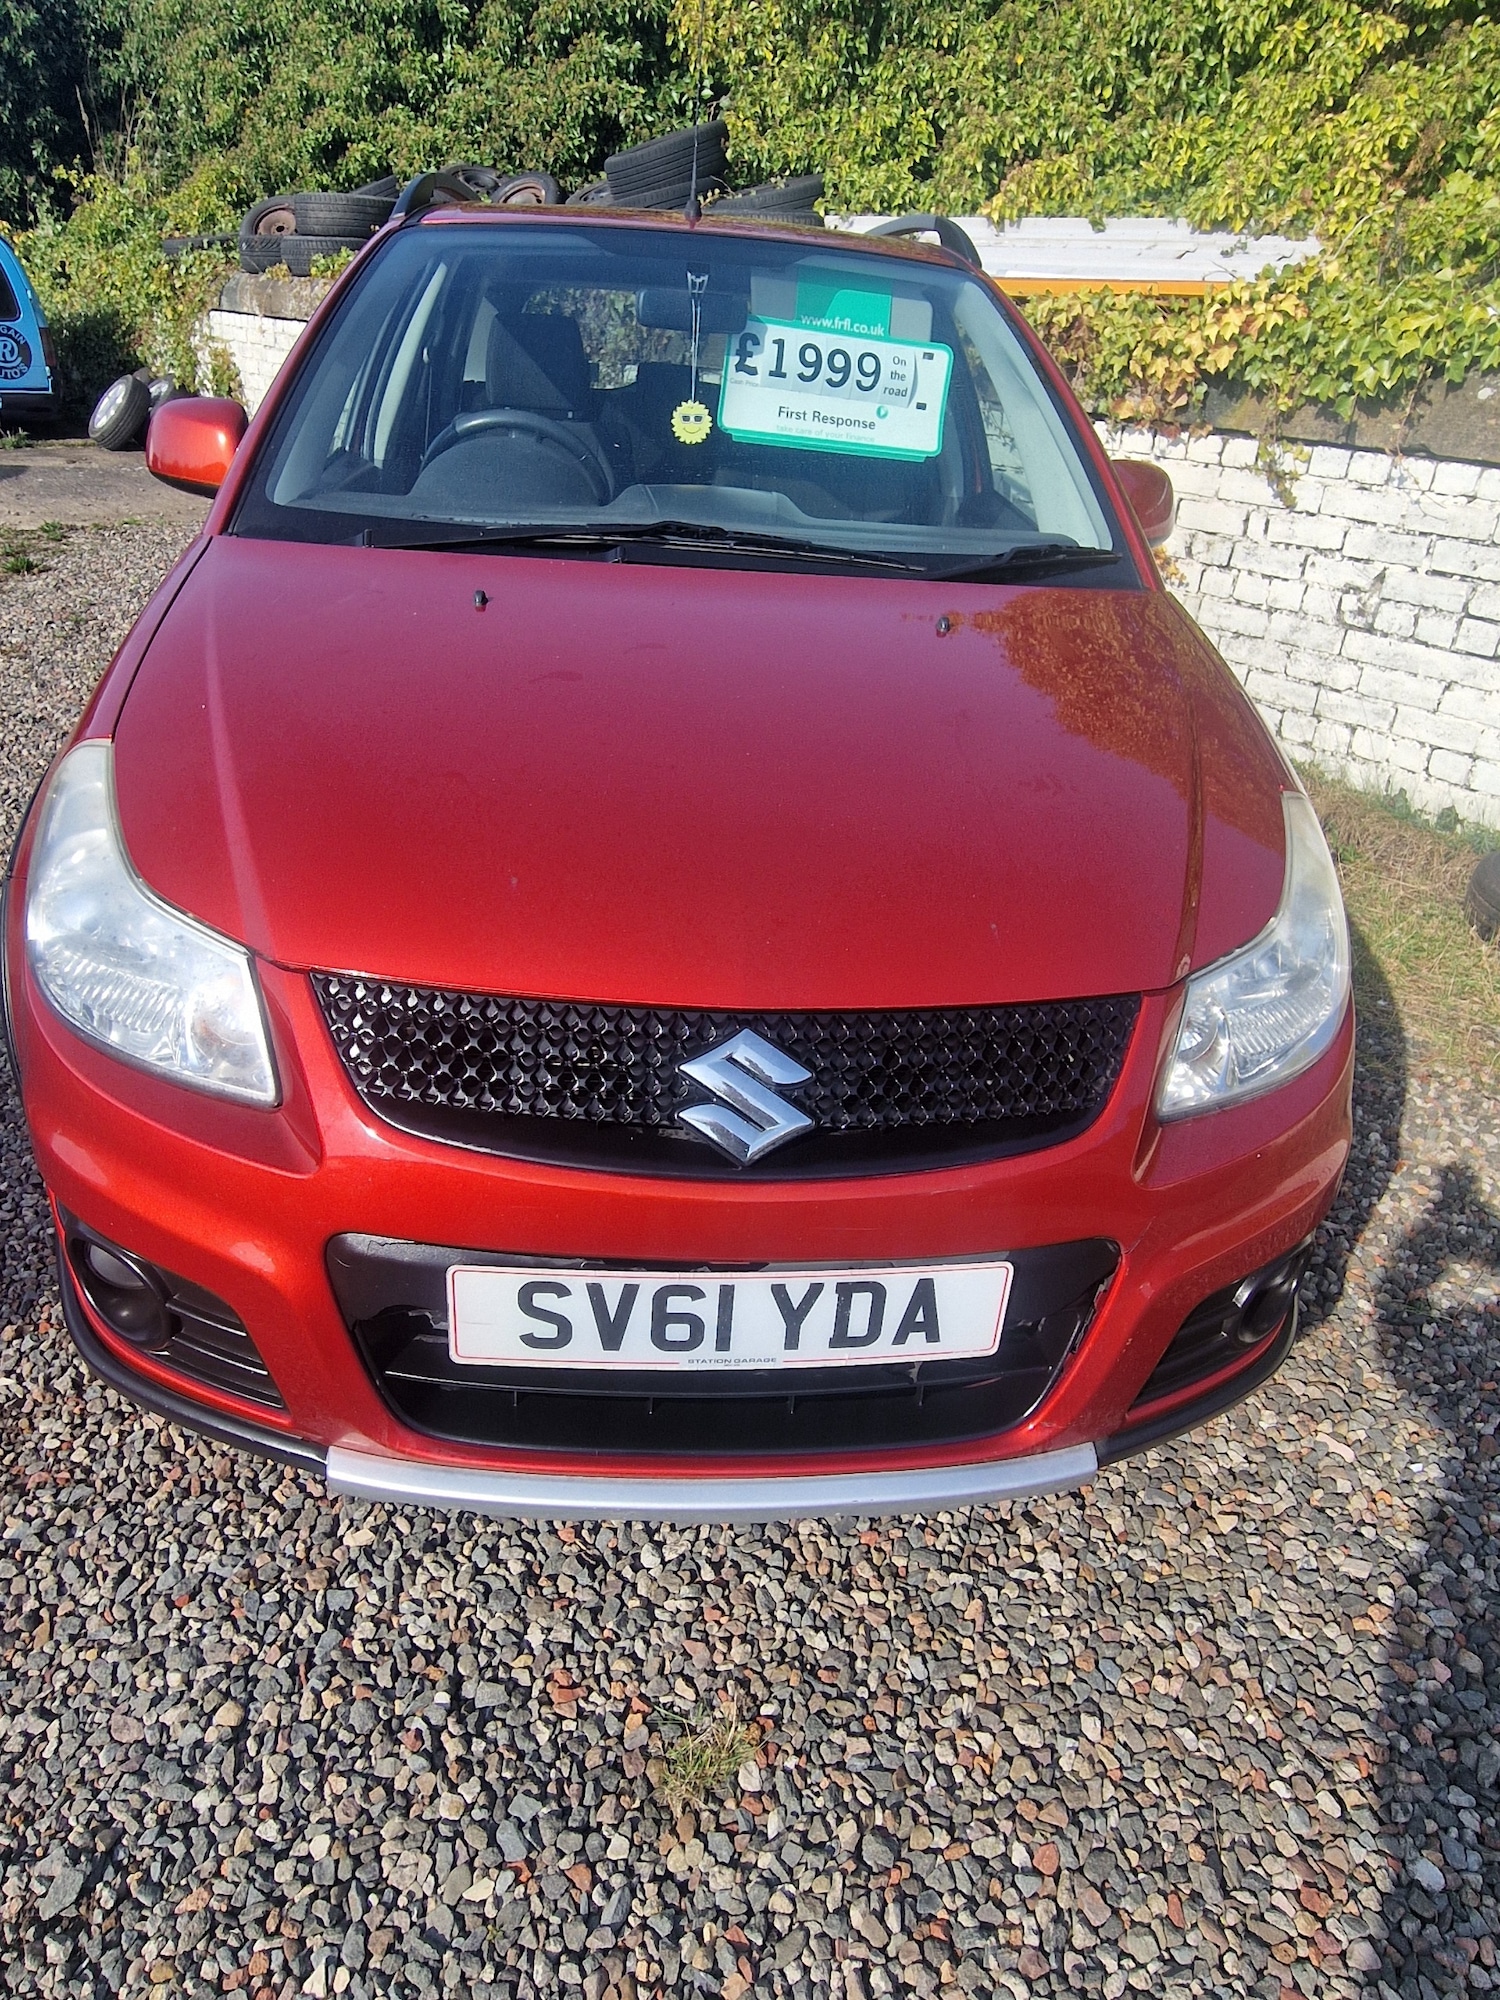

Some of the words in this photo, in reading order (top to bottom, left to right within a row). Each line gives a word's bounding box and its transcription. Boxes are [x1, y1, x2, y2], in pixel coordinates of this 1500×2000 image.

[800, 315, 885, 337] www.frfl.co.uk
[735, 332, 881, 392] £1999
[892, 355, 907, 367] On
[890, 370, 906, 381] the
[883, 386, 908, 397] road
[778, 406, 807, 421] First
[812, 410, 876, 430] Response
[776, 424, 793, 433] take
[795, 427, 813, 436] care
[815, 428, 823, 436] of
[825, 431, 844, 440] your
[846, 432, 875, 443] finance
[517, 1280, 733, 1352] SV61
[770, 1278, 942, 1351] YDA
